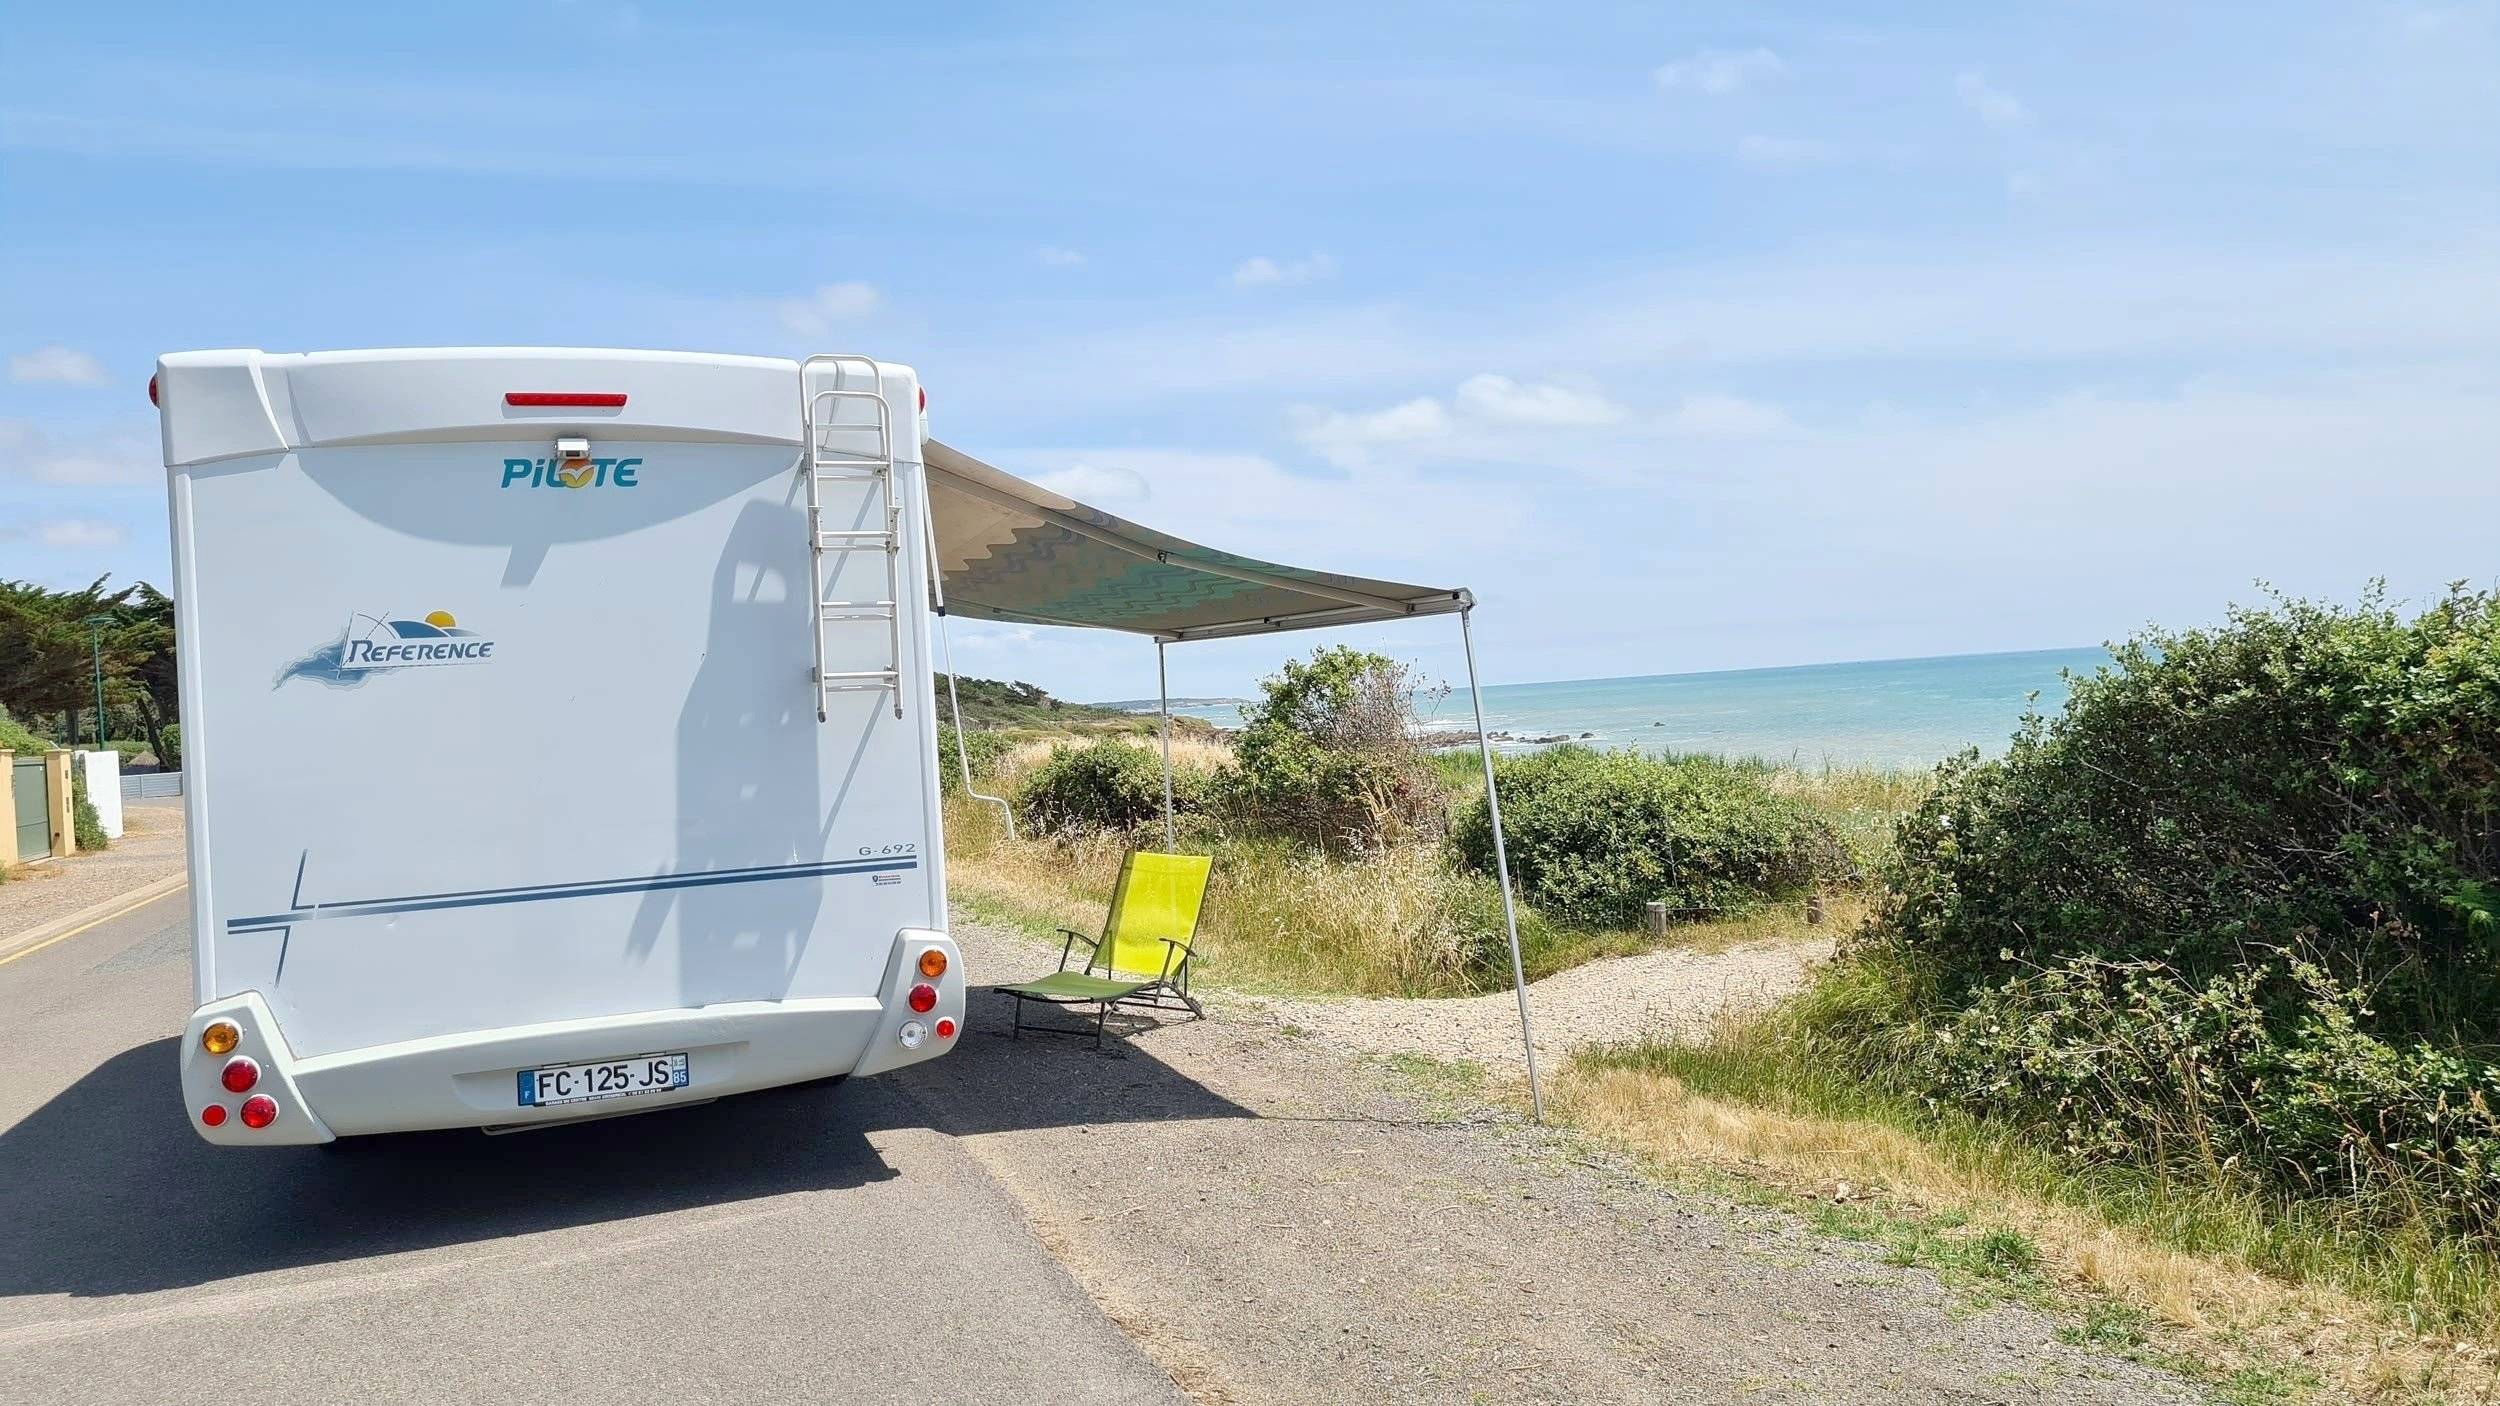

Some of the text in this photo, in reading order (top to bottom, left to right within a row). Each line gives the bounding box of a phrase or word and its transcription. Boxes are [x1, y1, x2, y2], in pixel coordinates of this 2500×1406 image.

[350, 640, 494, 663] REFERENCE
[859, 843, 915, 856] G-692
[524, 1090, 531, 1099] F
[673, 1071, 687, 1084] 85
